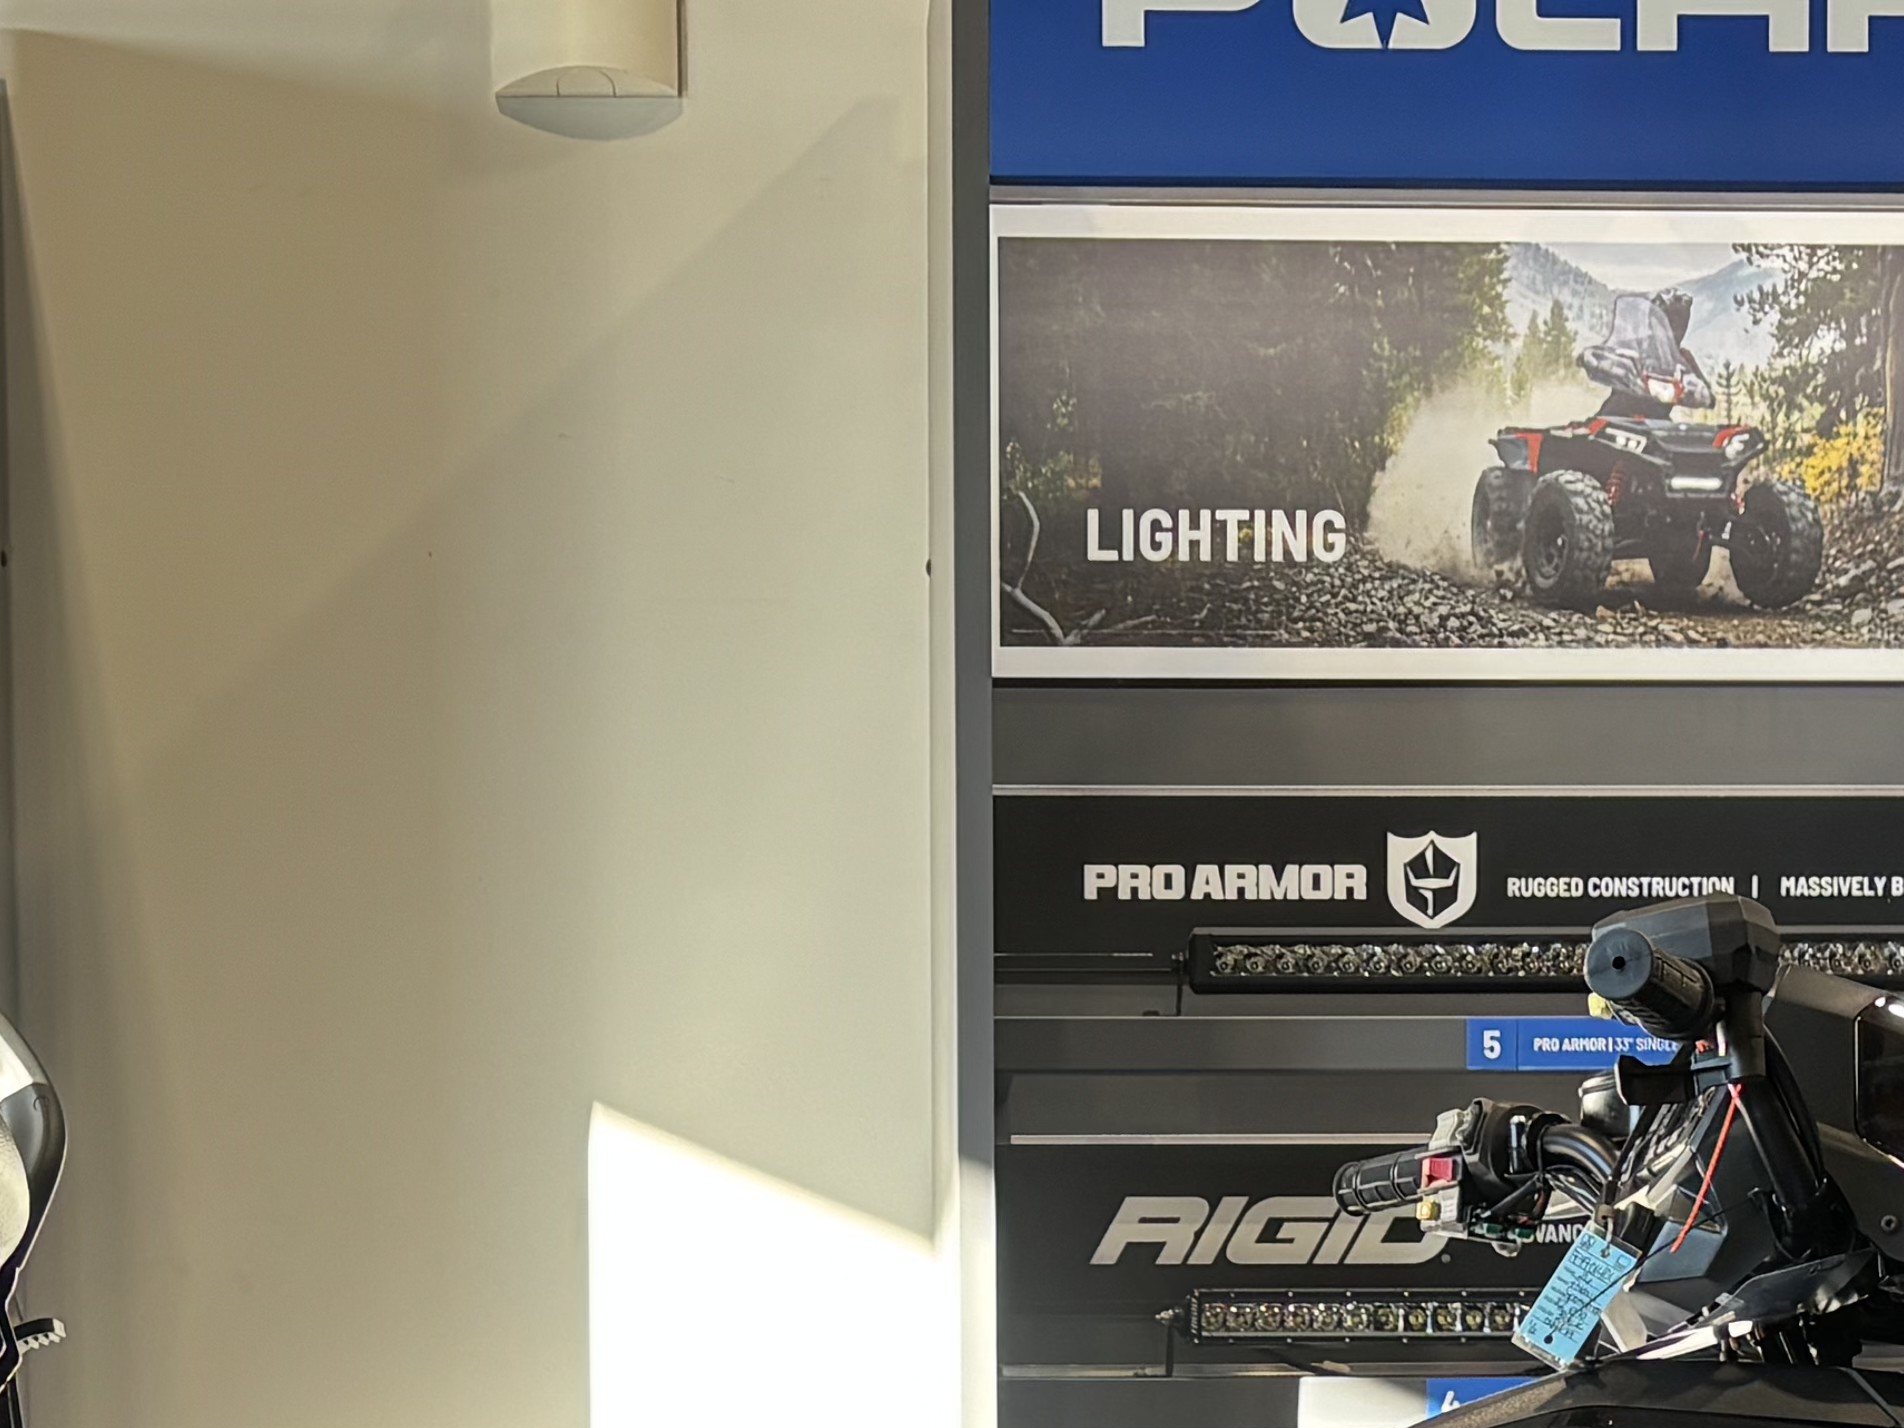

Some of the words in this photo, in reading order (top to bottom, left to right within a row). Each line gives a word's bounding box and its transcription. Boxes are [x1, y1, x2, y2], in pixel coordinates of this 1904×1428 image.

[1086, 507, 1347, 563] LIGHTING
[1083, 864, 1185, 900] PRO
[1190, 864, 1368, 900] ARMOR
[1507, 876, 1584, 898] RUGGED
[1587, 876, 1735, 898] CONSTRUCTION
[1780, 876, 1885, 898] MASSIVELY
[1483, 1029, 1502, 1060] 5
[1533, 1036, 1558, 1053] PRO
[1560, 1036, 1607, 1053] ARMOR
[1615, 1035, 1633, 1053] 33"
